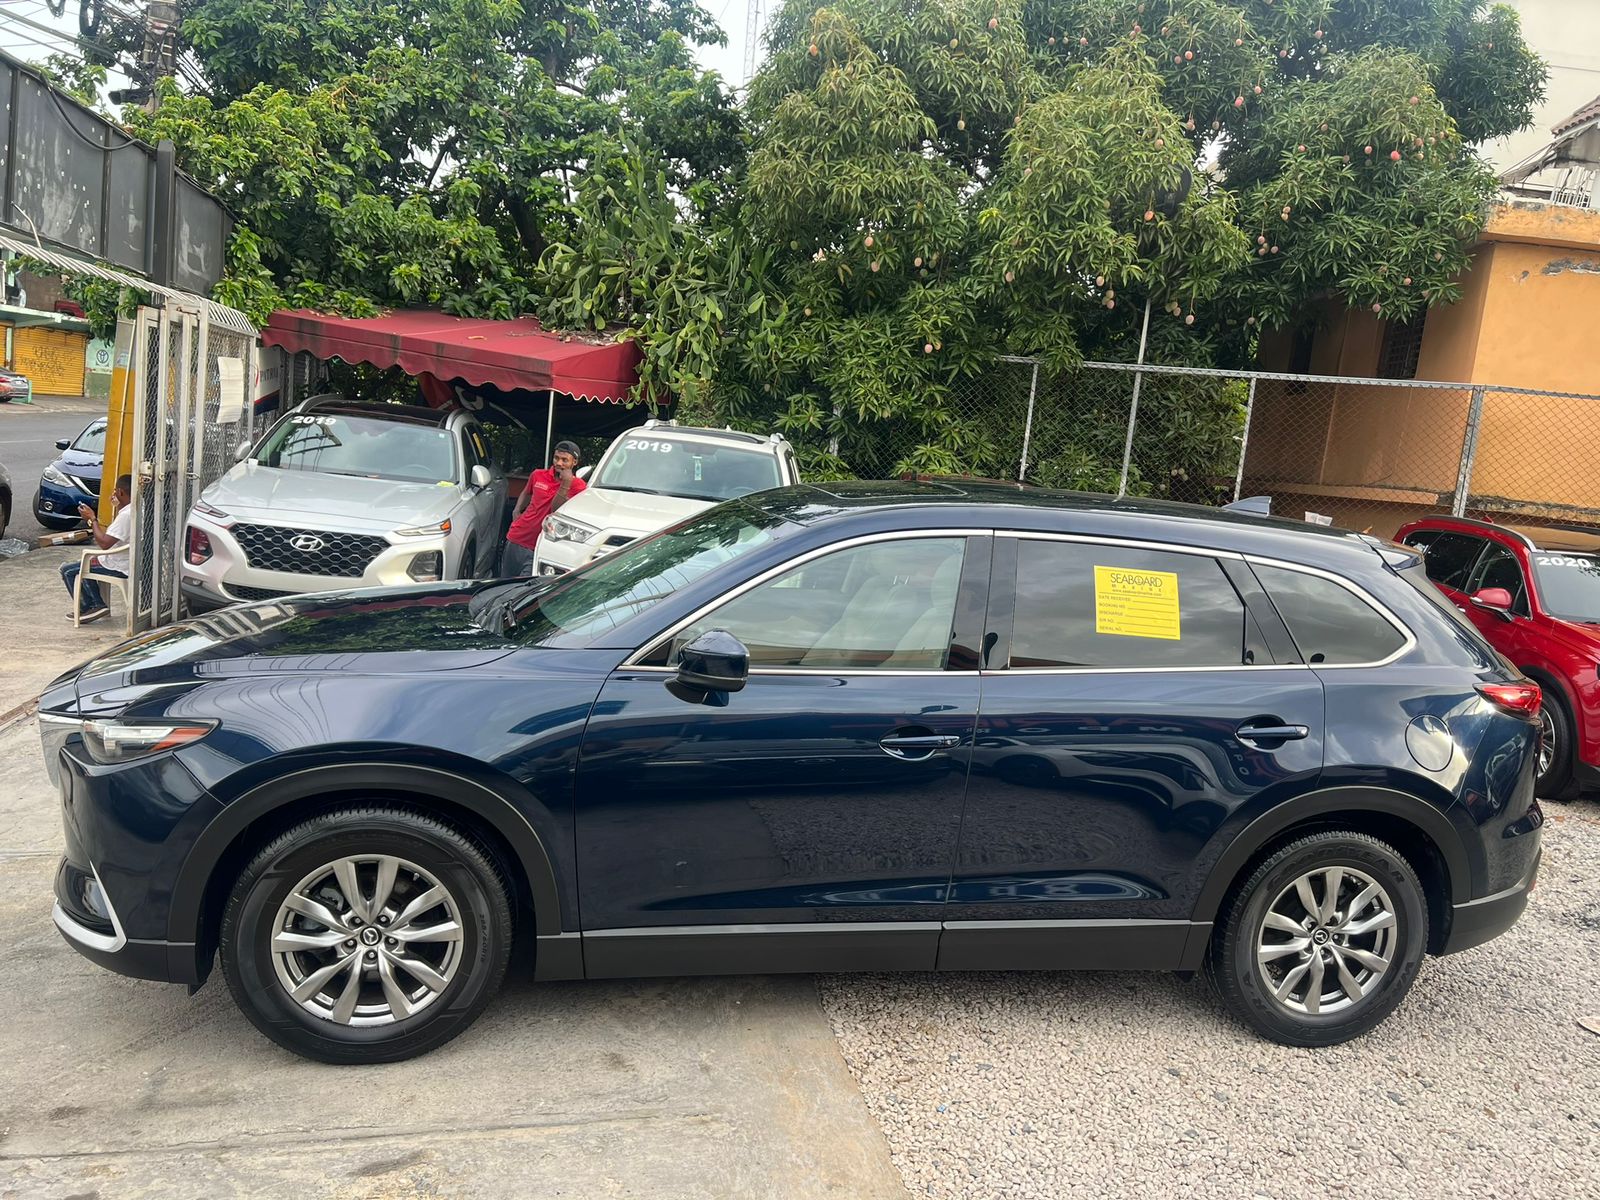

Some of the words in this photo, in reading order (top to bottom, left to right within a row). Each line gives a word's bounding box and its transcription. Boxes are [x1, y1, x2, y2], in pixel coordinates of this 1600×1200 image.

[291, 415, 337, 426] 2019
[625, 439, 673, 453] 2019
[1536, 556, 1592, 569] 2020
[1110, 573, 1163, 588] SEABOARD
